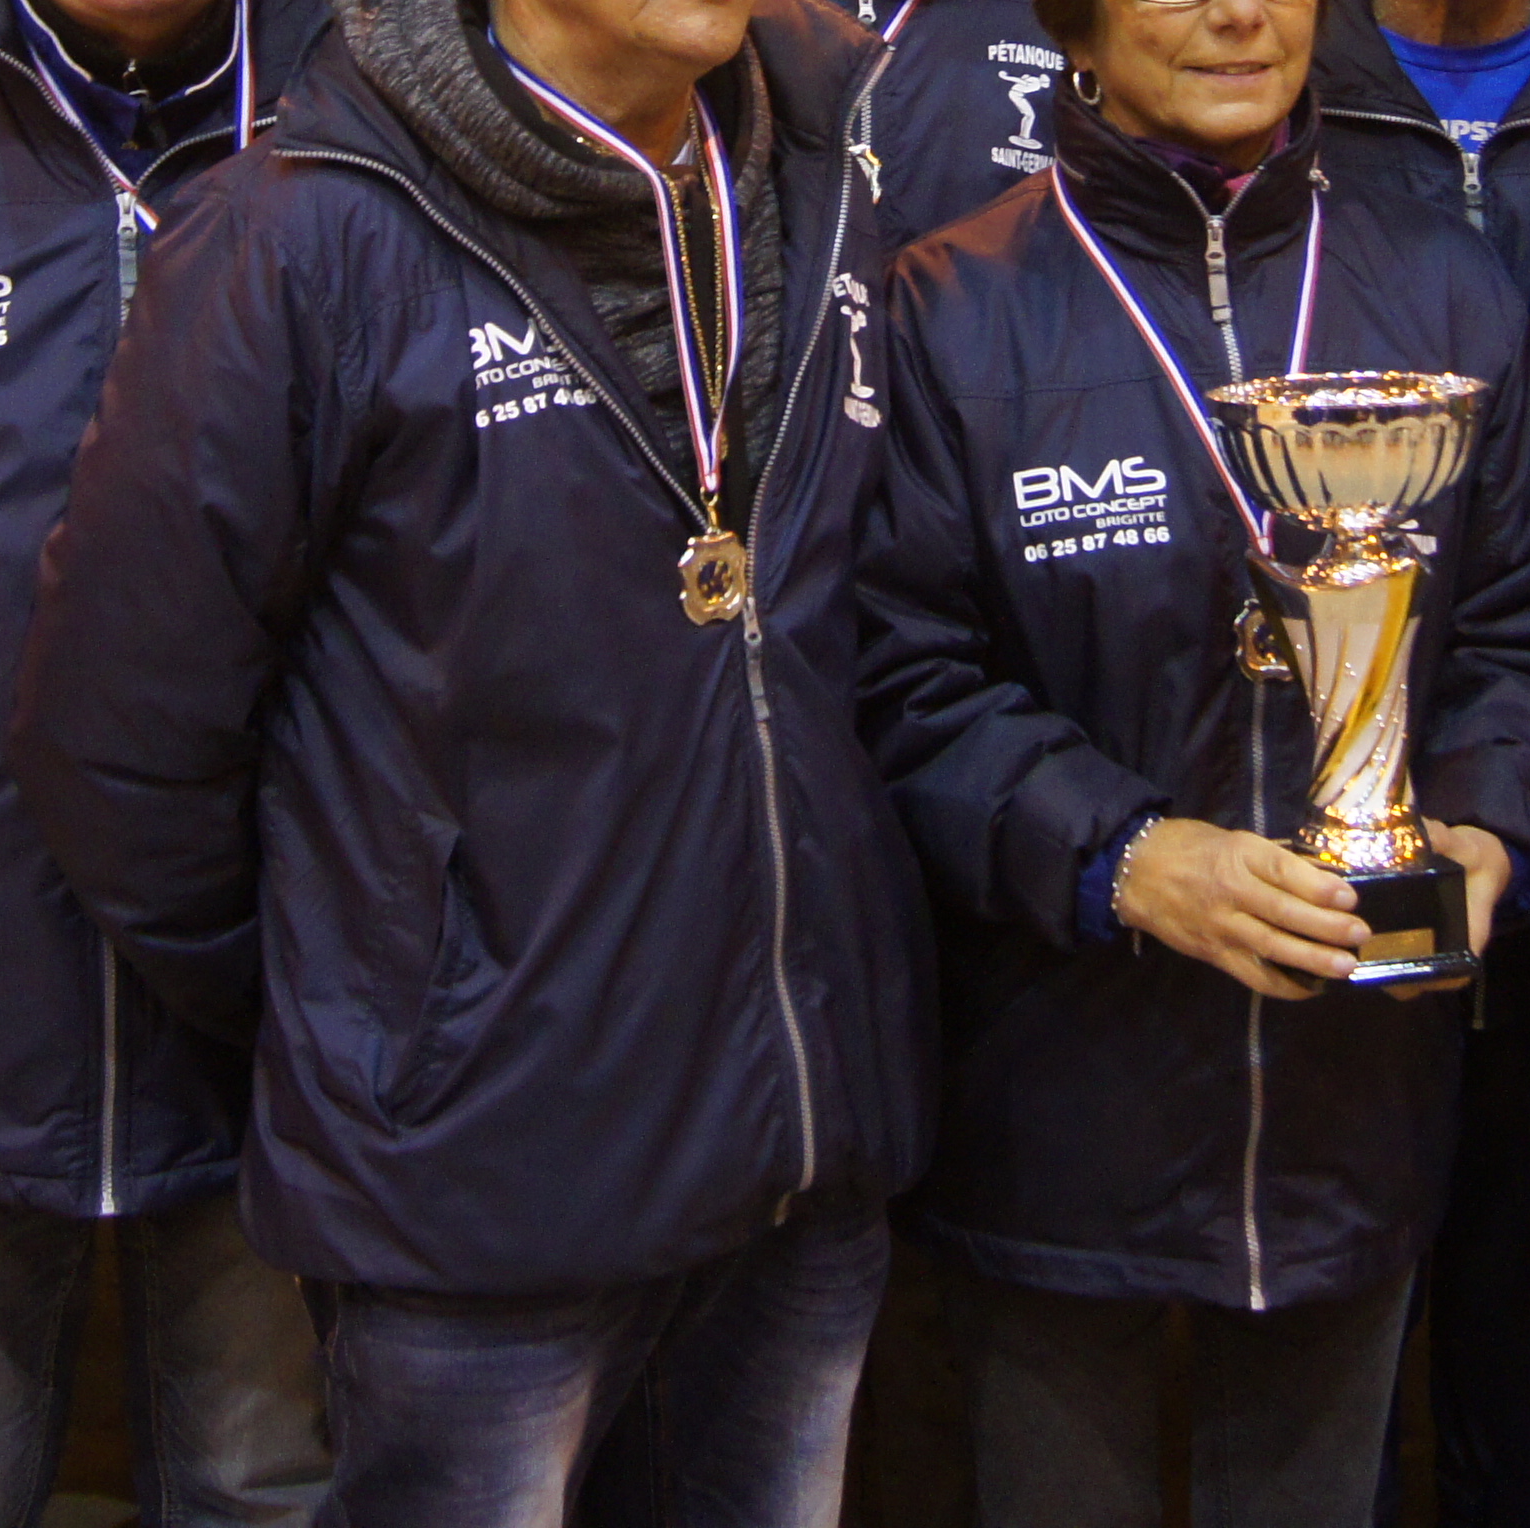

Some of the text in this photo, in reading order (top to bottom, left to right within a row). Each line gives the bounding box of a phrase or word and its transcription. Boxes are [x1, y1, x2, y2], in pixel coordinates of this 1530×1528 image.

[987, 39, 1066, 72] PÉTANQUE
[492, 399, 520, 423] 25
[522, 391, 548, 415] 87
[1012, 455, 1168, 510] BMS
[1019, 493, 1168, 528] LOTO CONCEPT
[1095, 510, 1167, 530] BRIGITTE
[1023, 525, 1171, 563] 06 25 87 48 66
